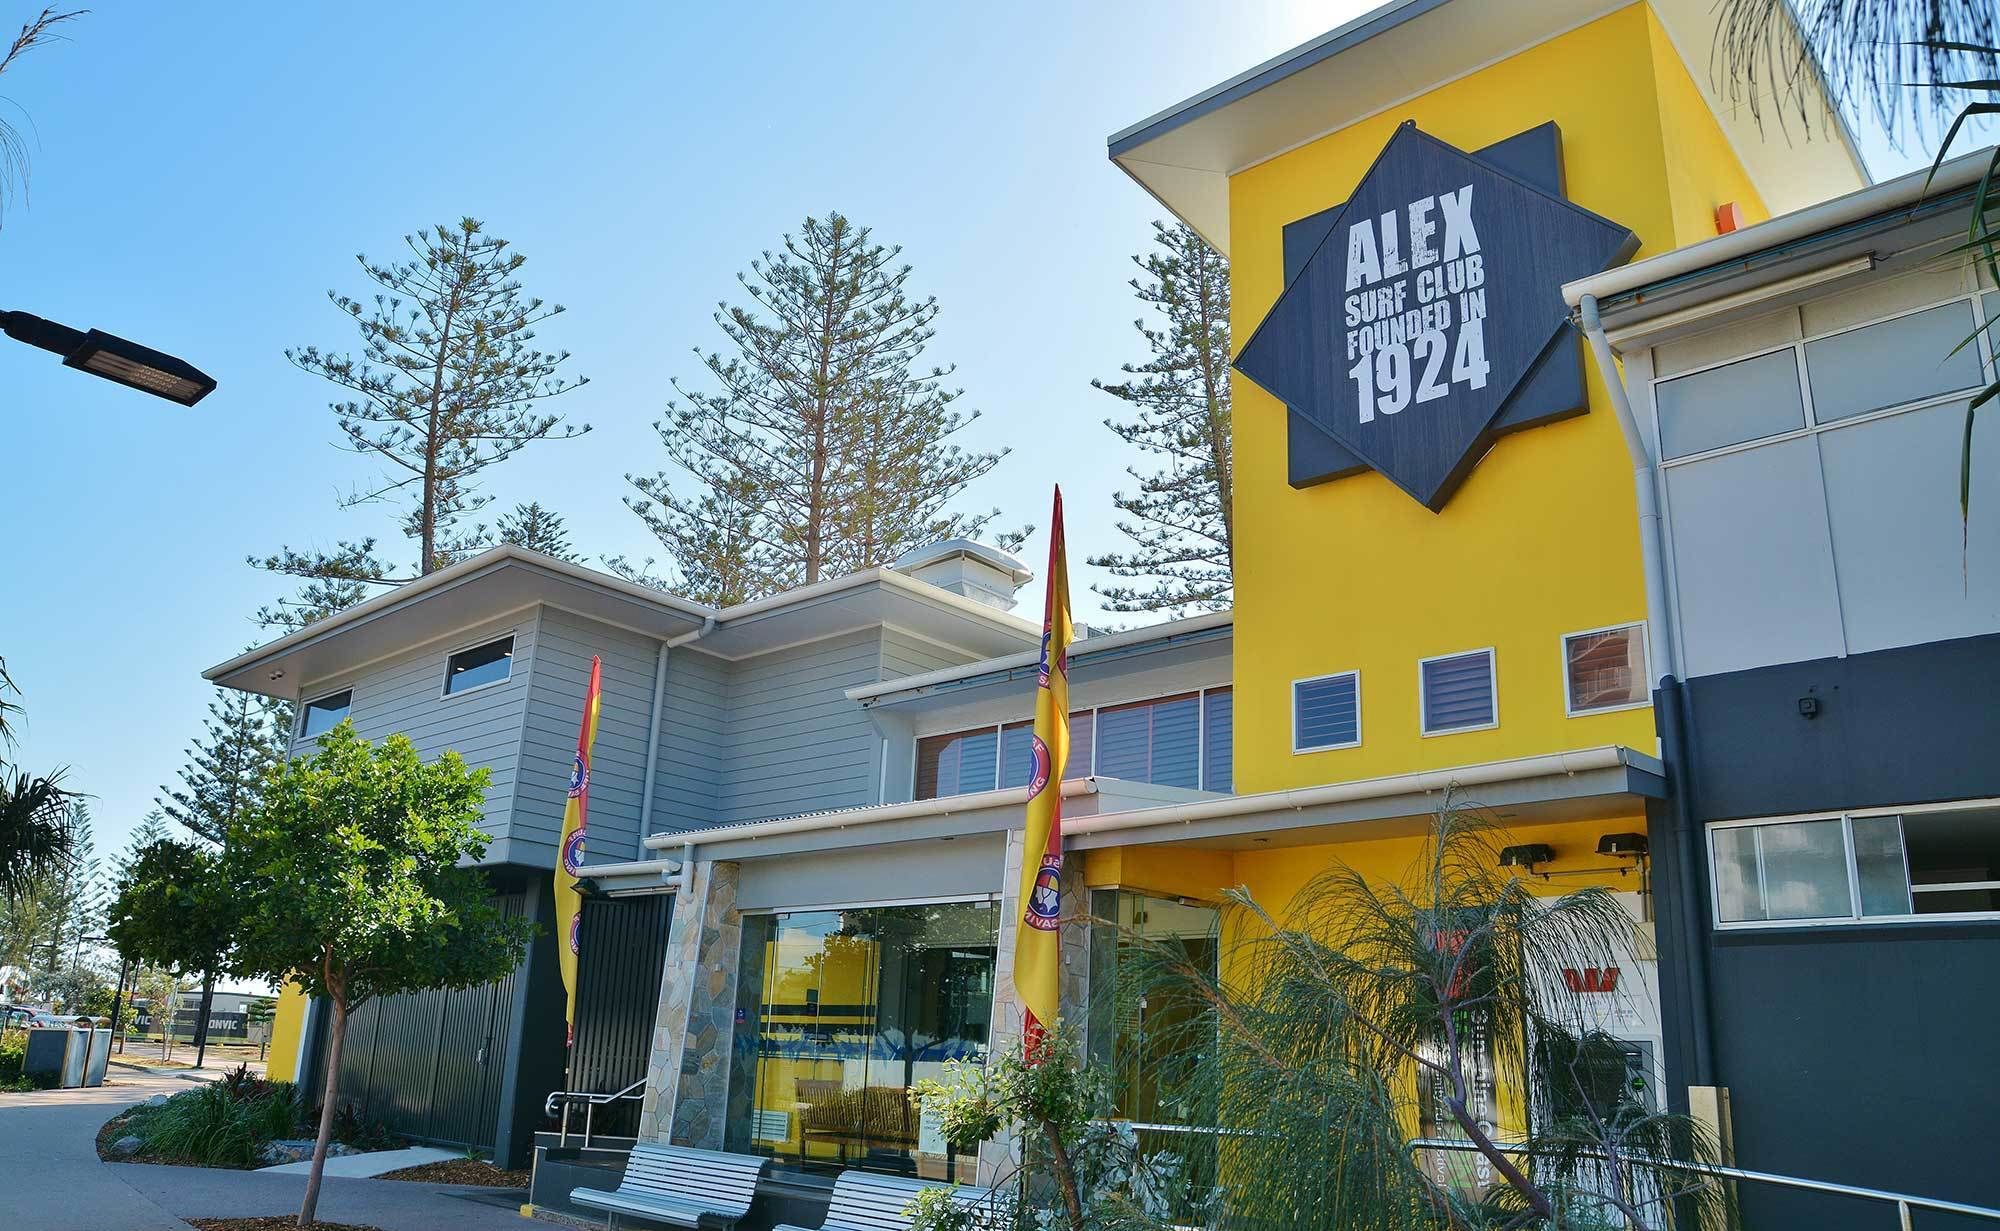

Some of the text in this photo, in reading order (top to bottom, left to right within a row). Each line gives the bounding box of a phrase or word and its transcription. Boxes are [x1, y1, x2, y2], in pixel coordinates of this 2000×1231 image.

[1345, 184, 1481, 292] ALEX
[1345, 254, 1485, 327] SURF CLUB
[1346, 287, 1487, 361] FOUNDED IN
[1348, 318, 1490, 424] 1924
[208, 1019, 238, 1030] ONVIC
[1470, 1009, 1495, 1189] Sunhine Cast
